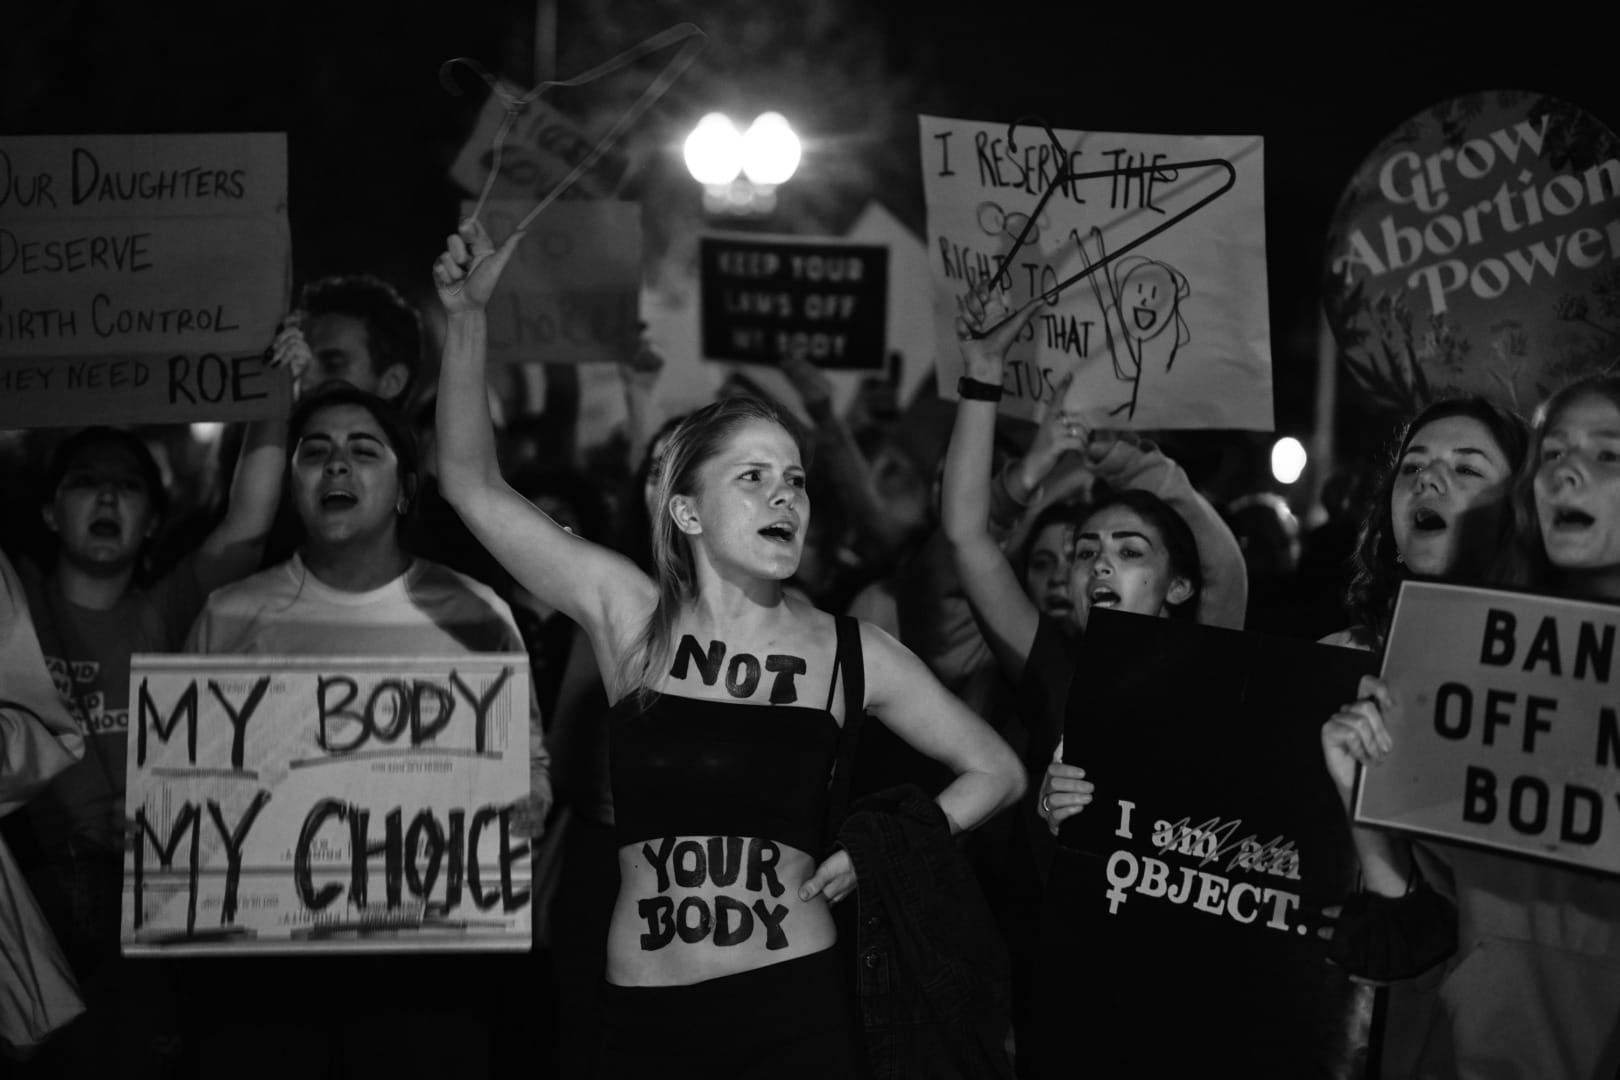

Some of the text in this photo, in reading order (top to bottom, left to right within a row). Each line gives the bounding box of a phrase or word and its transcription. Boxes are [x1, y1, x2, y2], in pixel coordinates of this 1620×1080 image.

[72, 148, 245, 204] DAUGHTERS
[934, 131, 1179, 214] I RESERVE THE
[1379, 114, 1550, 213] Grow
[1332, 157, 1620, 286] Abortion
[0, 229, 152, 275] DESERVE
[791, 254, 864, 282] YOUR
[804, 293, 854, 320] OFF
[1021, 263, 1060, 307] TO
[0, 294, 239, 340] IRTH CONTROL
[1040, 314, 1095, 358] THAT
[67, 362, 149, 389] NEED
[168, 354, 268, 405] ROE
[669, 634, 807, 705] NOT
[137, 666, 514, 769] MY BODY
[1434, 681, 1558, 754] OFF
[1115, 800, 1136, 839] I
[1462, 764, 1620, 846] BOD
[134, 788, 530, 937] MY CHOICE
[642, 836, 786, 898] YOUR
[1105, 850, 1307, 936] OBJECT.
[638, 895, 789, 951] BODY
